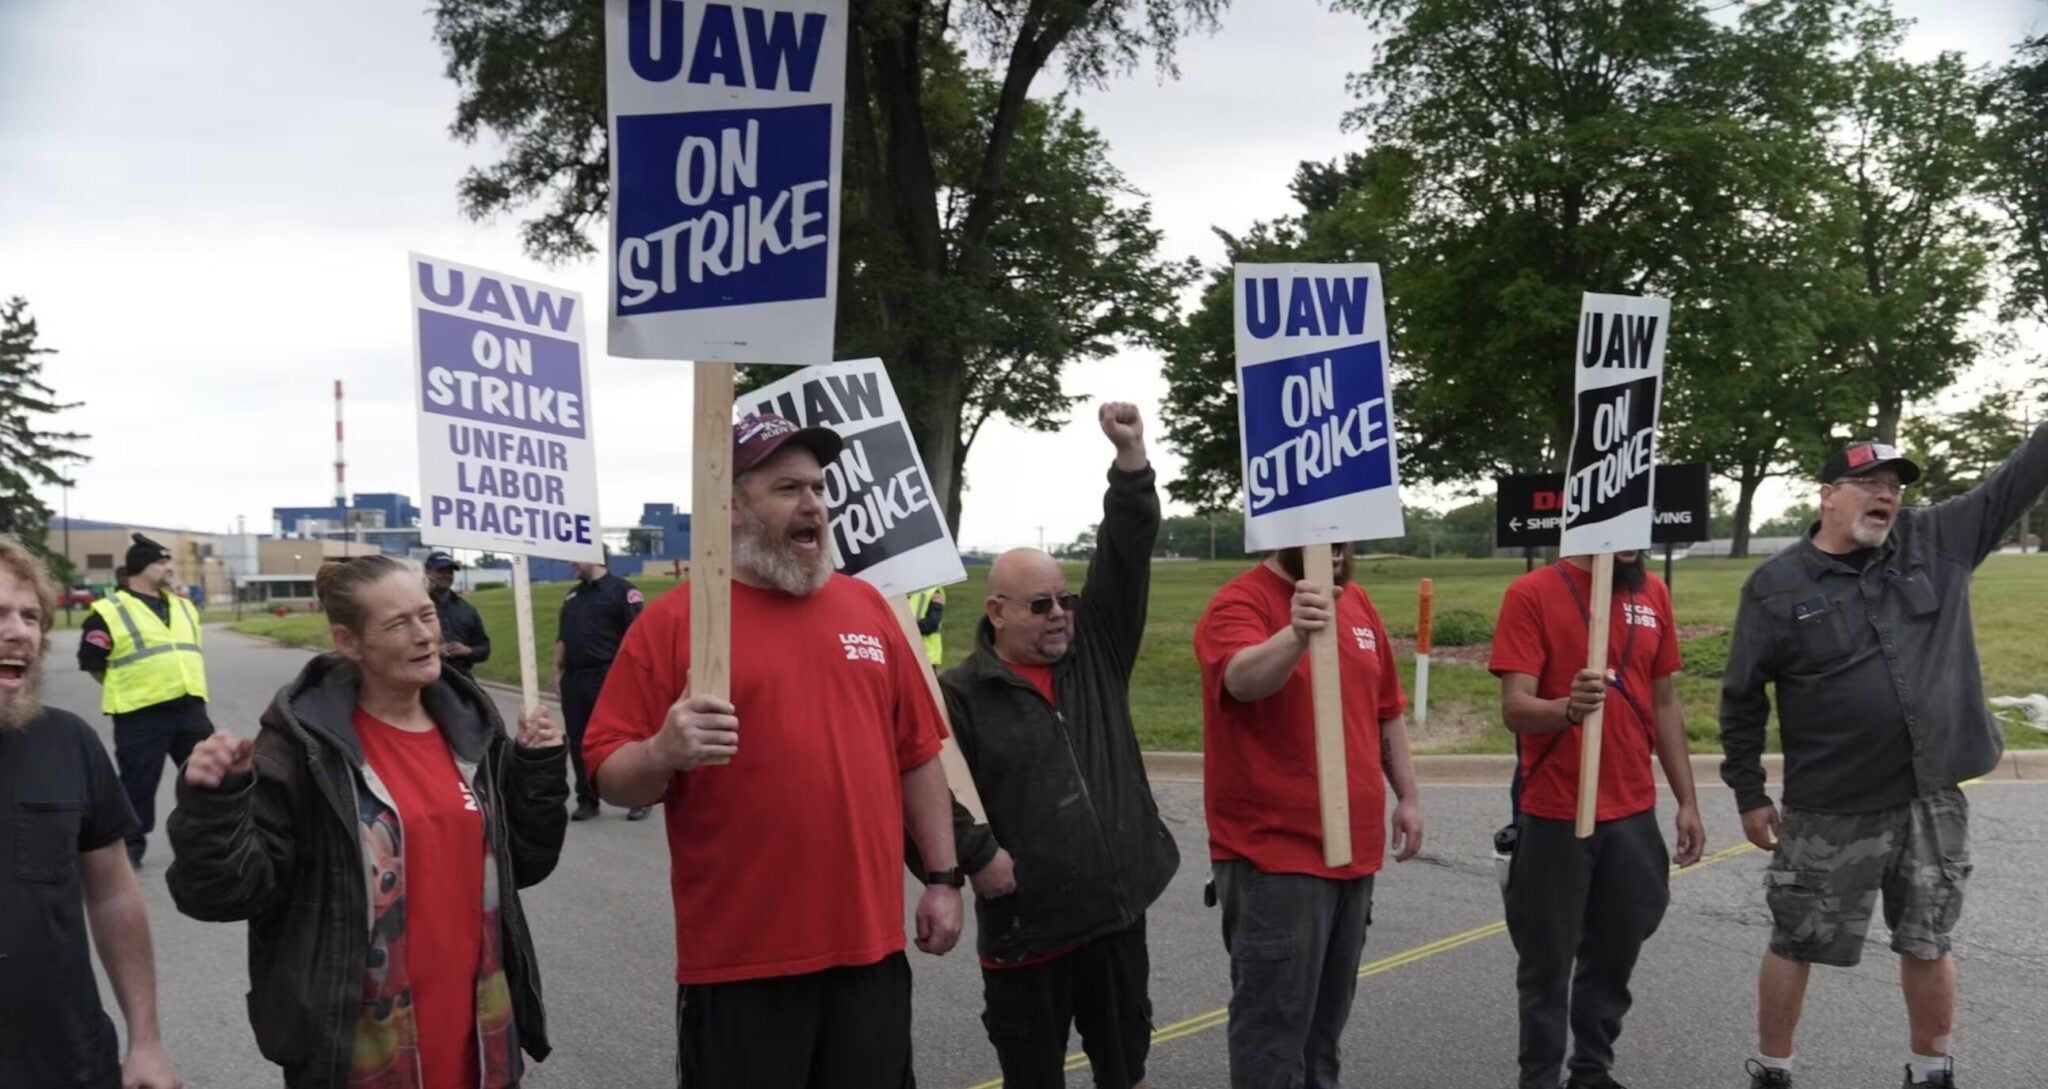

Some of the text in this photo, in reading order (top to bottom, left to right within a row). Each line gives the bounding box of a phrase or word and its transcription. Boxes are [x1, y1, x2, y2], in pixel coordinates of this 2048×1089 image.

[628, 0, 827, 92] UAW
[676, 118, 759, 206] ON
[618, 180, 829, 306] STRIKE
[417, 261, 575, 332] UAW
[1245, 277, 1368, 339] UAW
[472, 330, 533, 376] ON
[1582, 312, 1658, 369] UAW
[427, 366, 581, 428] STRIKE
[1281, 358, 1334, 427] ON
[1593, 389, 1630, 451] ON
[449, 424, 568, 471] UNFAIR
[821, 439, 874, 508] ON
[1249, 397, 1387, 509] STRIKE
[1566, 427, 1653, 524] STRIKE
[457, 461, 565, 505] LABOR
[431, 495, 592, 544] PRACTICE
[828, 466, 930, 570] TRIKE
[839, 633, 883, 649] LOCAL
[844, 645, 886, 665] 2093
